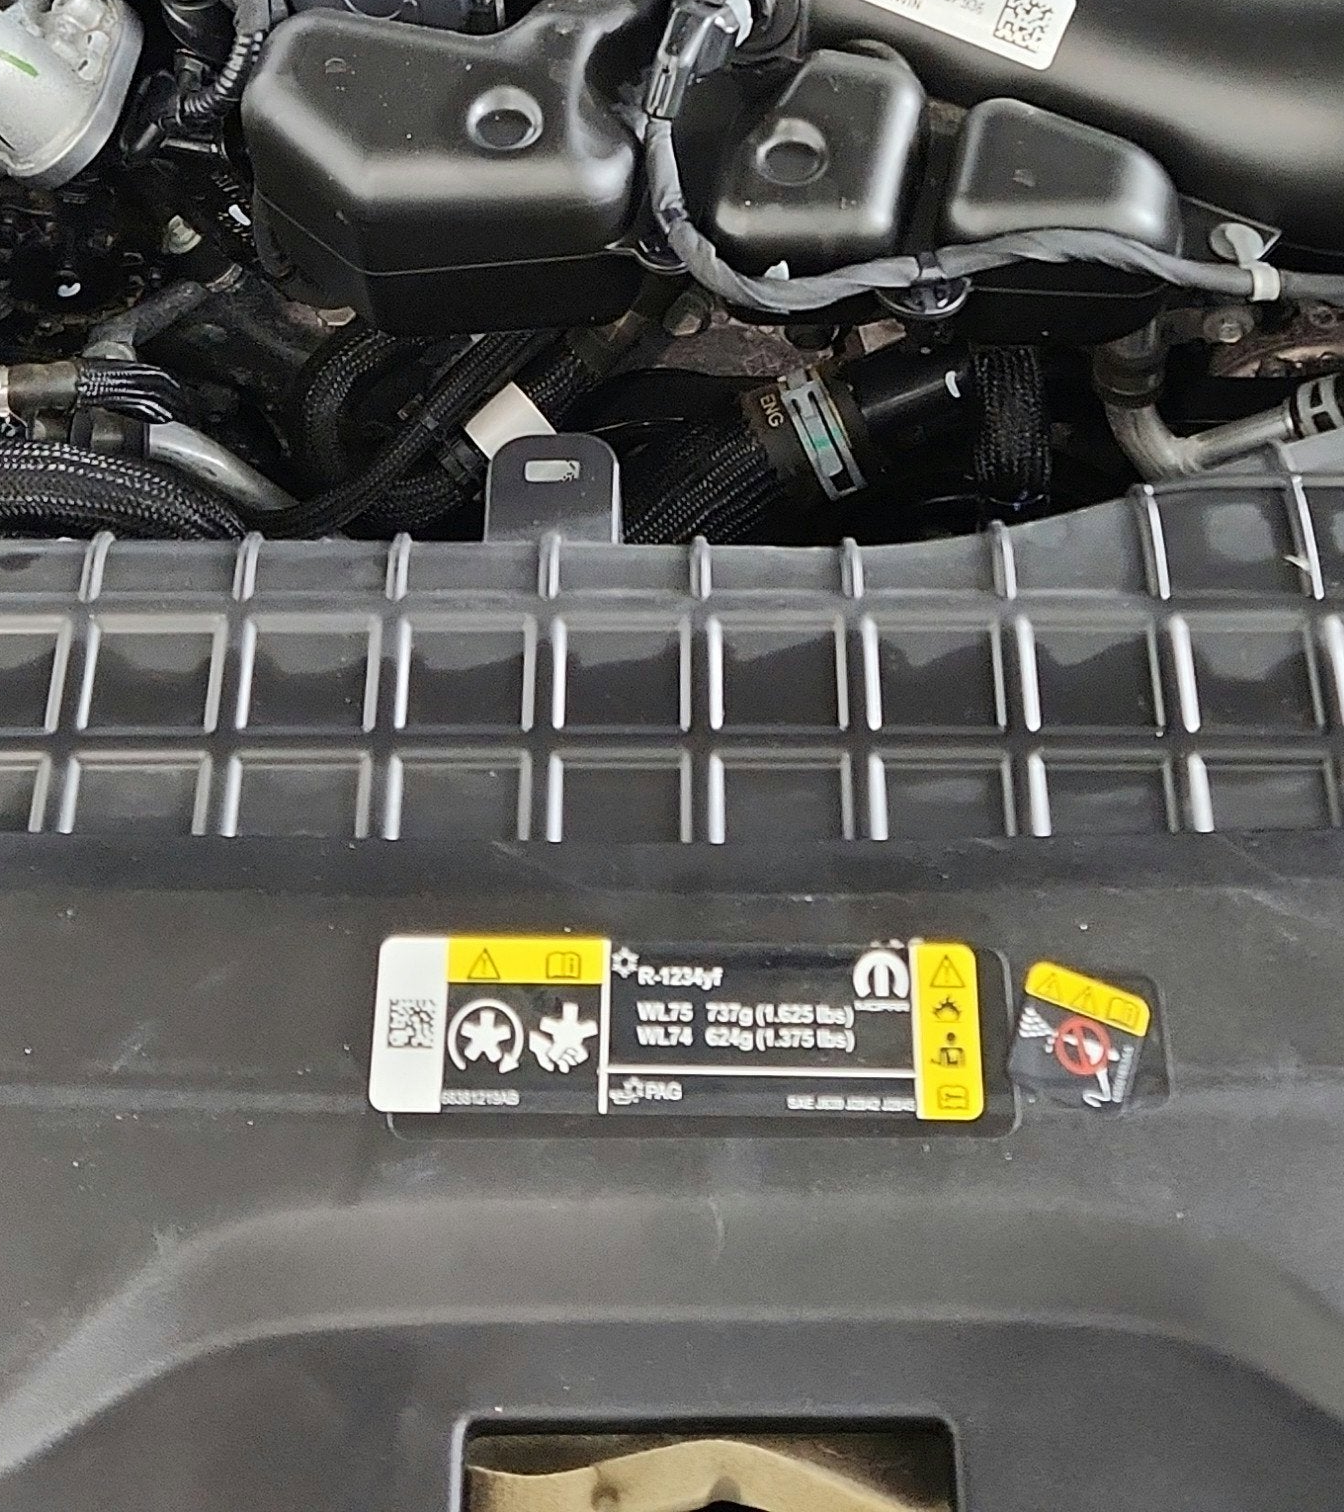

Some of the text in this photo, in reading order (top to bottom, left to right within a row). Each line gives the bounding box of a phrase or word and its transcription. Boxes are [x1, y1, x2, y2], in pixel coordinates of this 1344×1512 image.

[760, 394, 784, 427] ENG
[638, 966, 724, 991] R-1234yf
[636, 1001, 694, 1023] WL75
[705, 1002, 754, 1027] 737g
[816, 1003, 855, 1029] lbs)
[636, 1026, 856, 1053] WL74 624g (1.375 lbs)
[646, 1082, 683, 1101] PAG
